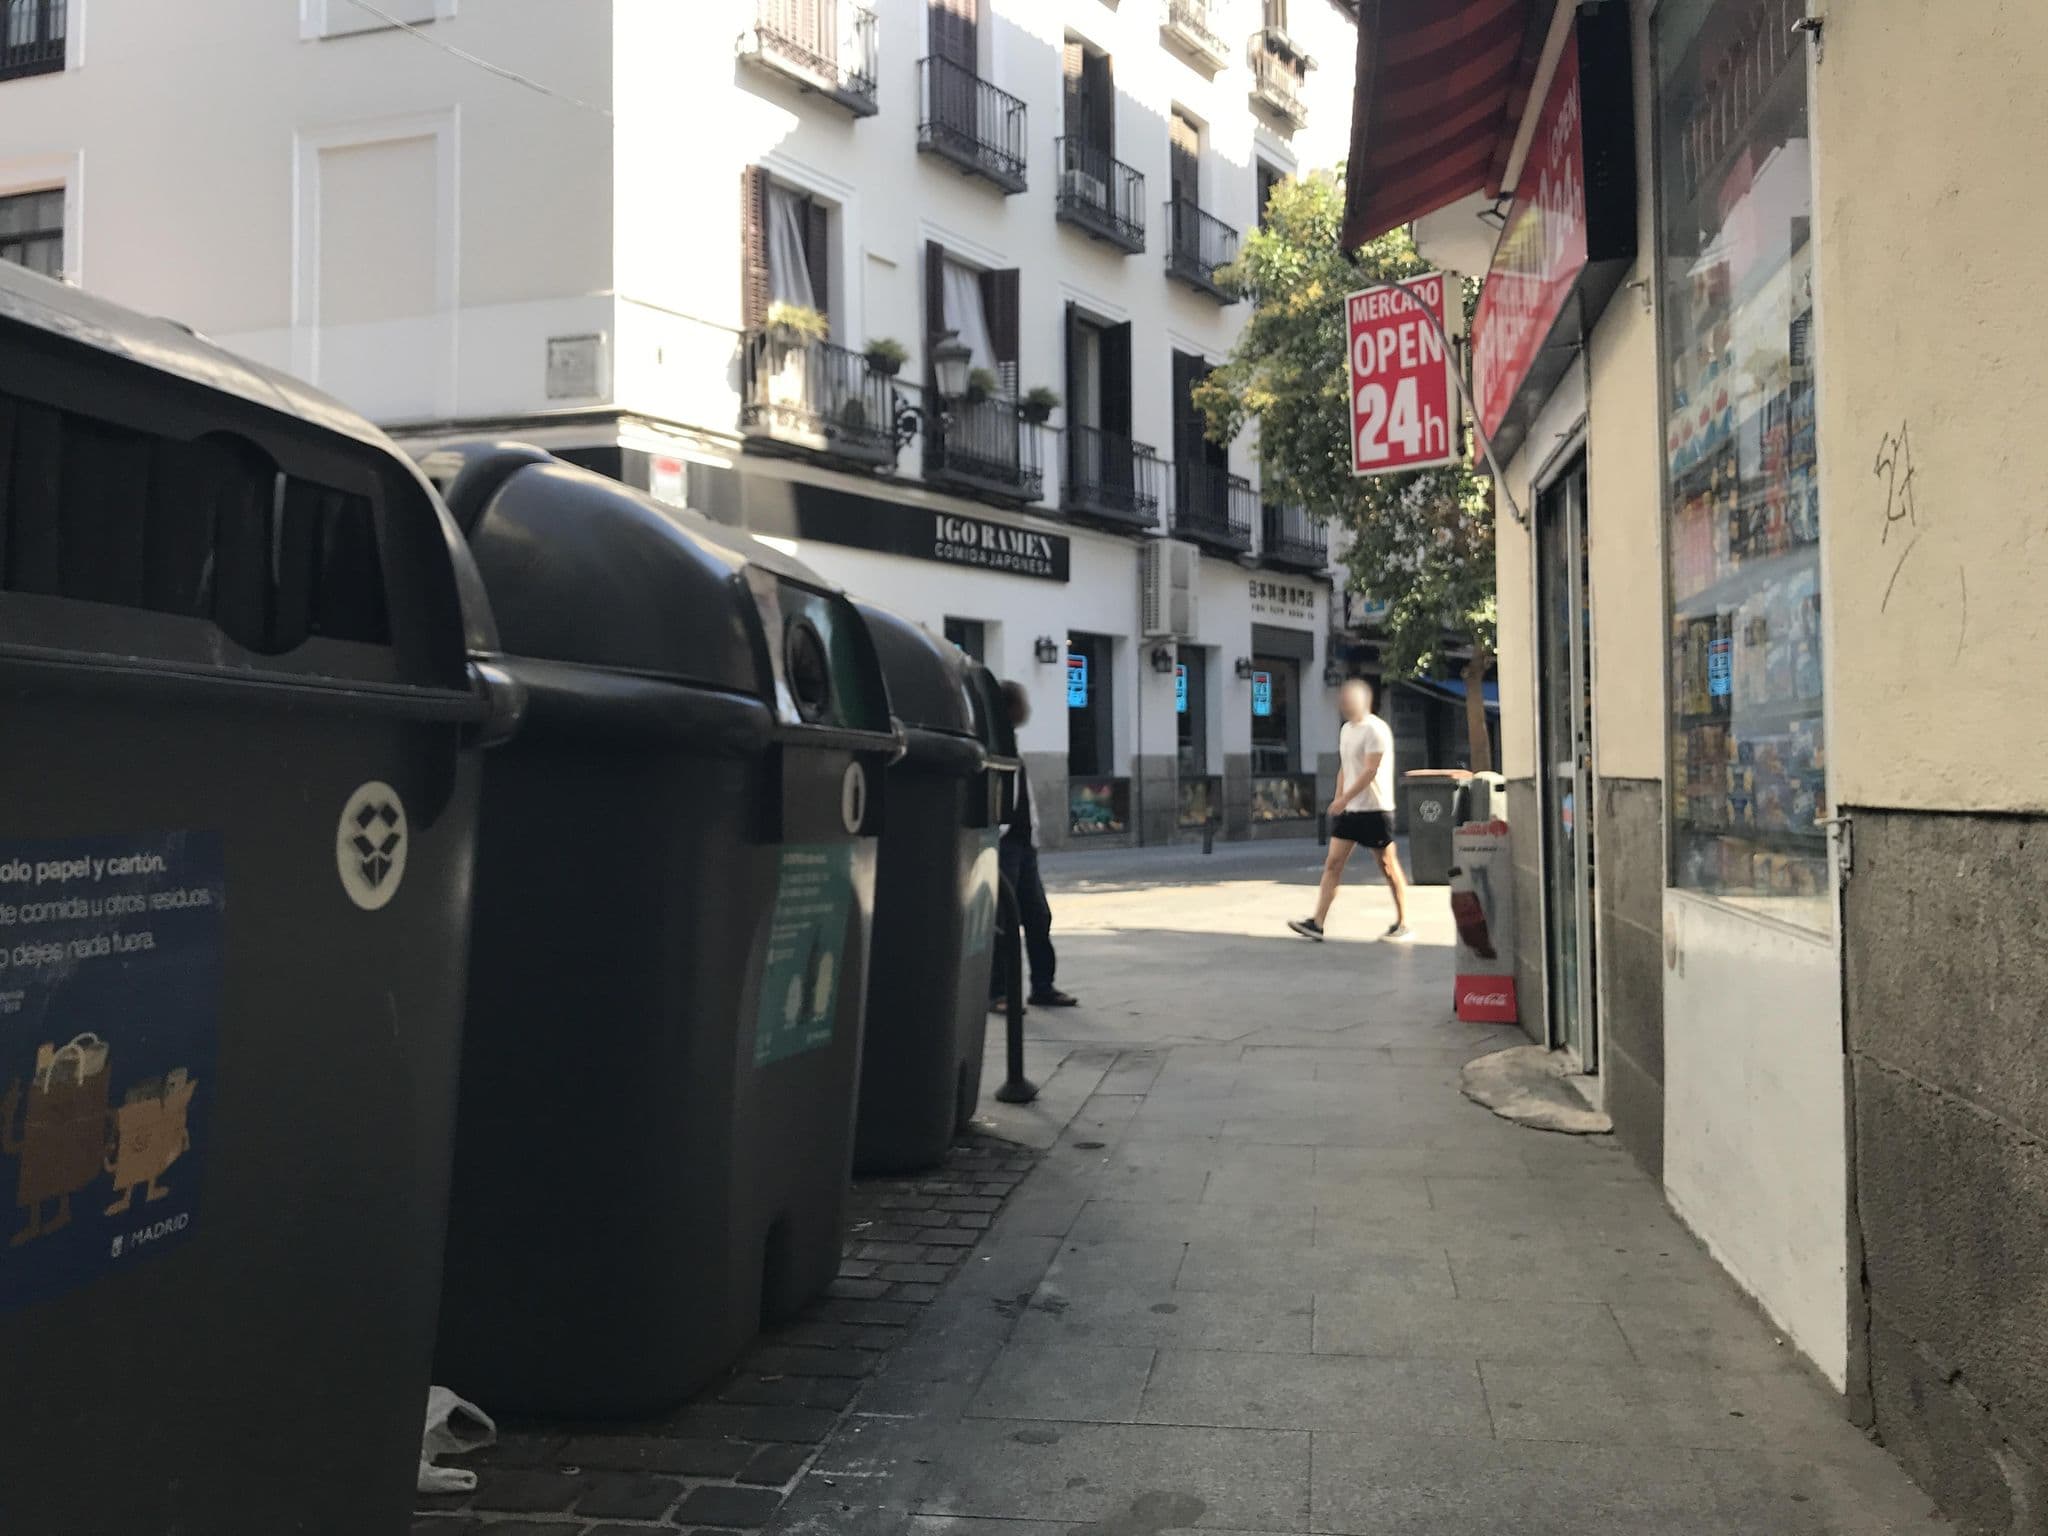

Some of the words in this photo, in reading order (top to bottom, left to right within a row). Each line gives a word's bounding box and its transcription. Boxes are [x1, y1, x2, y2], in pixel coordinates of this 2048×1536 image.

[1353, 281, 1439, 324] MERCADO
[1354, 319, 1443, 377] OPEN
[1356, 376, 1445, 463] 24h
[934, 542, 987, 563] COMIDA
[989, 552, 1052, 574] JAPONESA
[36, 855, 91, 885] papel
[92, 859, 106, 882] y
[20, 898, 88, 922] comida
[91, 899, 102, 916] u
[104, 894, 146, 914] otros
[13, 942, 63, 968] dejes
[68, 935, 110, 960] nada
[129, 1212, 189, 1246] MADRID
